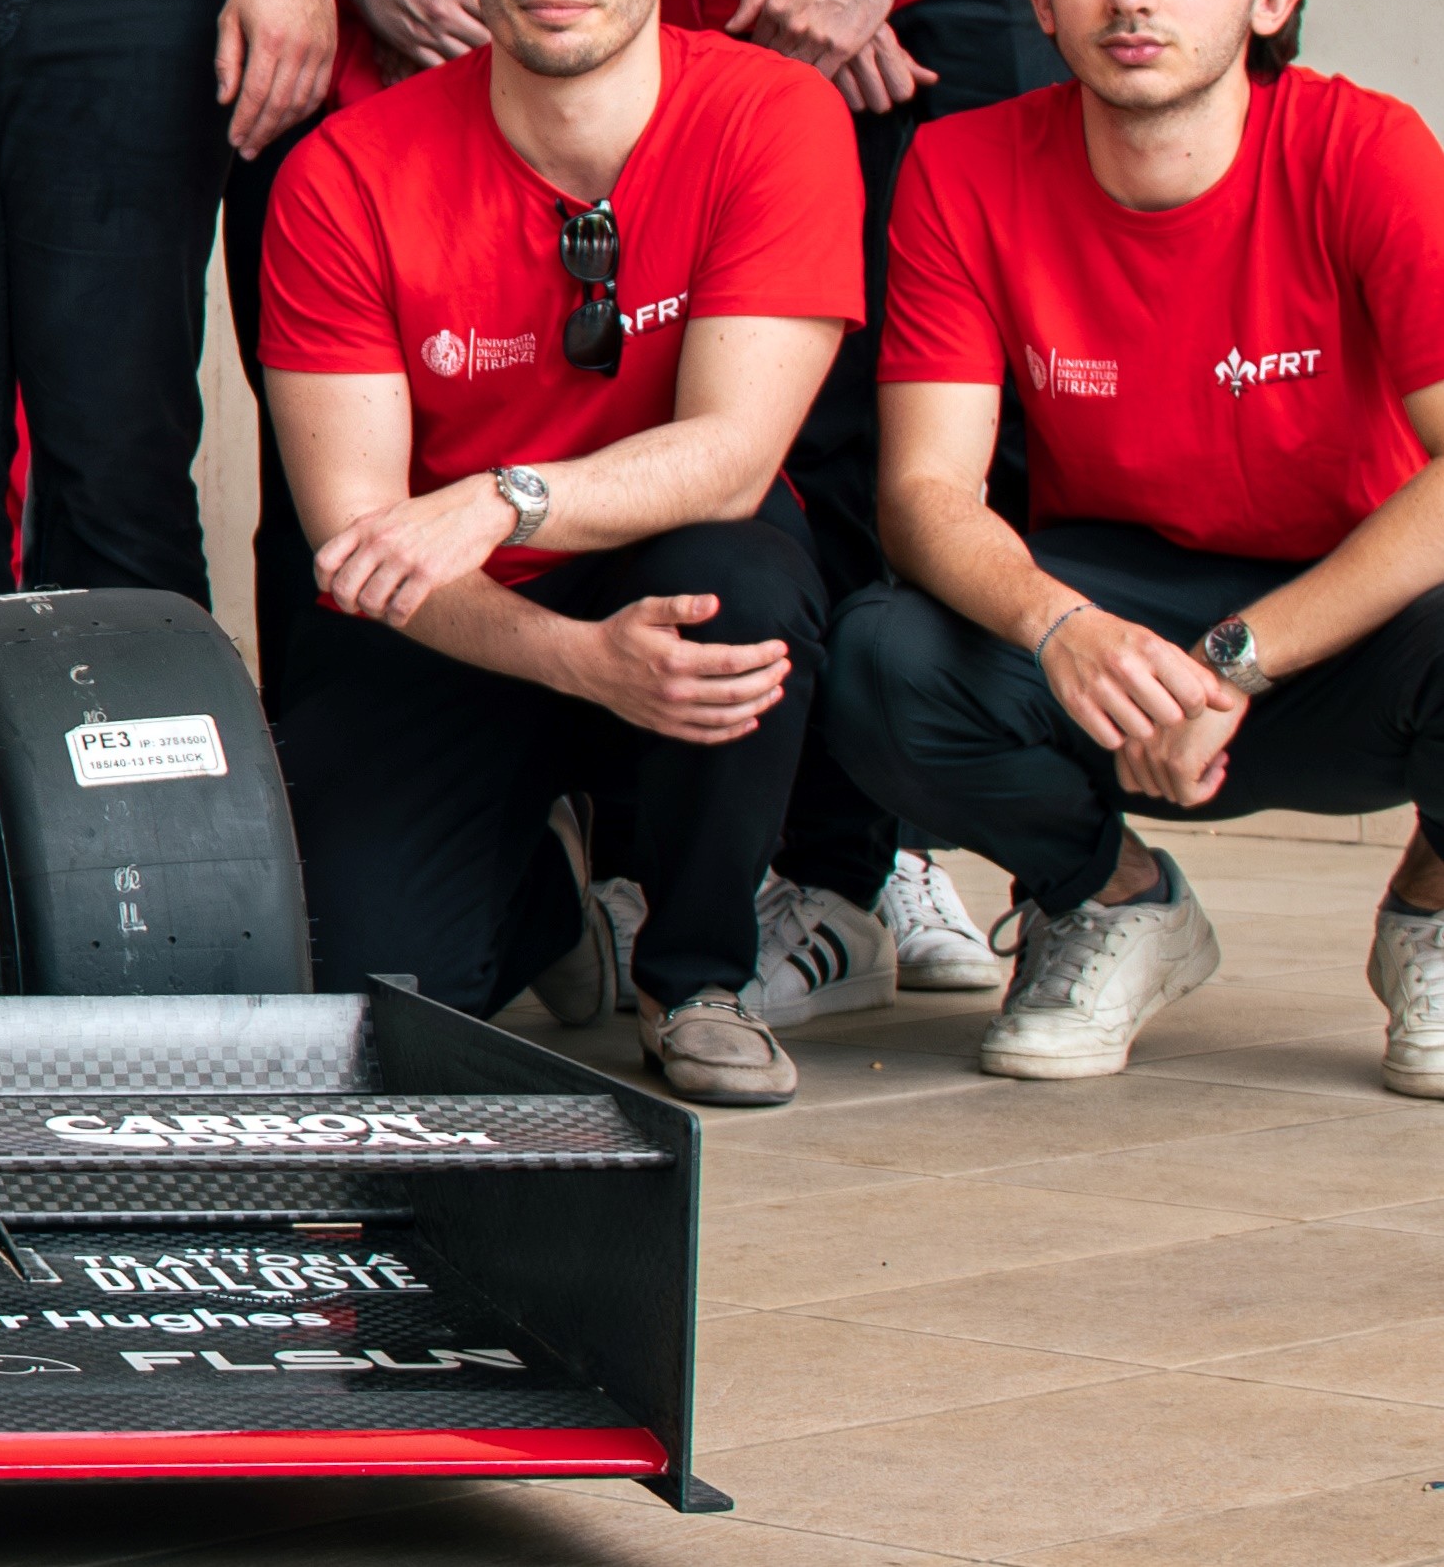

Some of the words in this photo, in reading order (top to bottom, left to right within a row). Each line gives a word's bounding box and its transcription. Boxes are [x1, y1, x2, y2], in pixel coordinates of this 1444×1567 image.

[476, 347, 505, 358] DEGLI
[507, 344, 536, 355] STUDI
[476, 353, 537, 372] FIRENZE
[1259, 350, 1321, 383] FRT
[1057, 369, 1086, 379] DEGLI
[1089, 371, 1118, 380] STUDI
[1057, 379, 1118, 398] FIRENZE
[82, 731, 131, 751] PE3
[149, 756, 164, 765] FS
[167, 753, 204, 764] SLICK
[46, 1114, 431, 1134] CARBON
[166, 1132, 501, 1146] DREAM
[74, 1253, 404, 1268] TRATTORIA
[42, 1308, 330, 1333] Hughes
